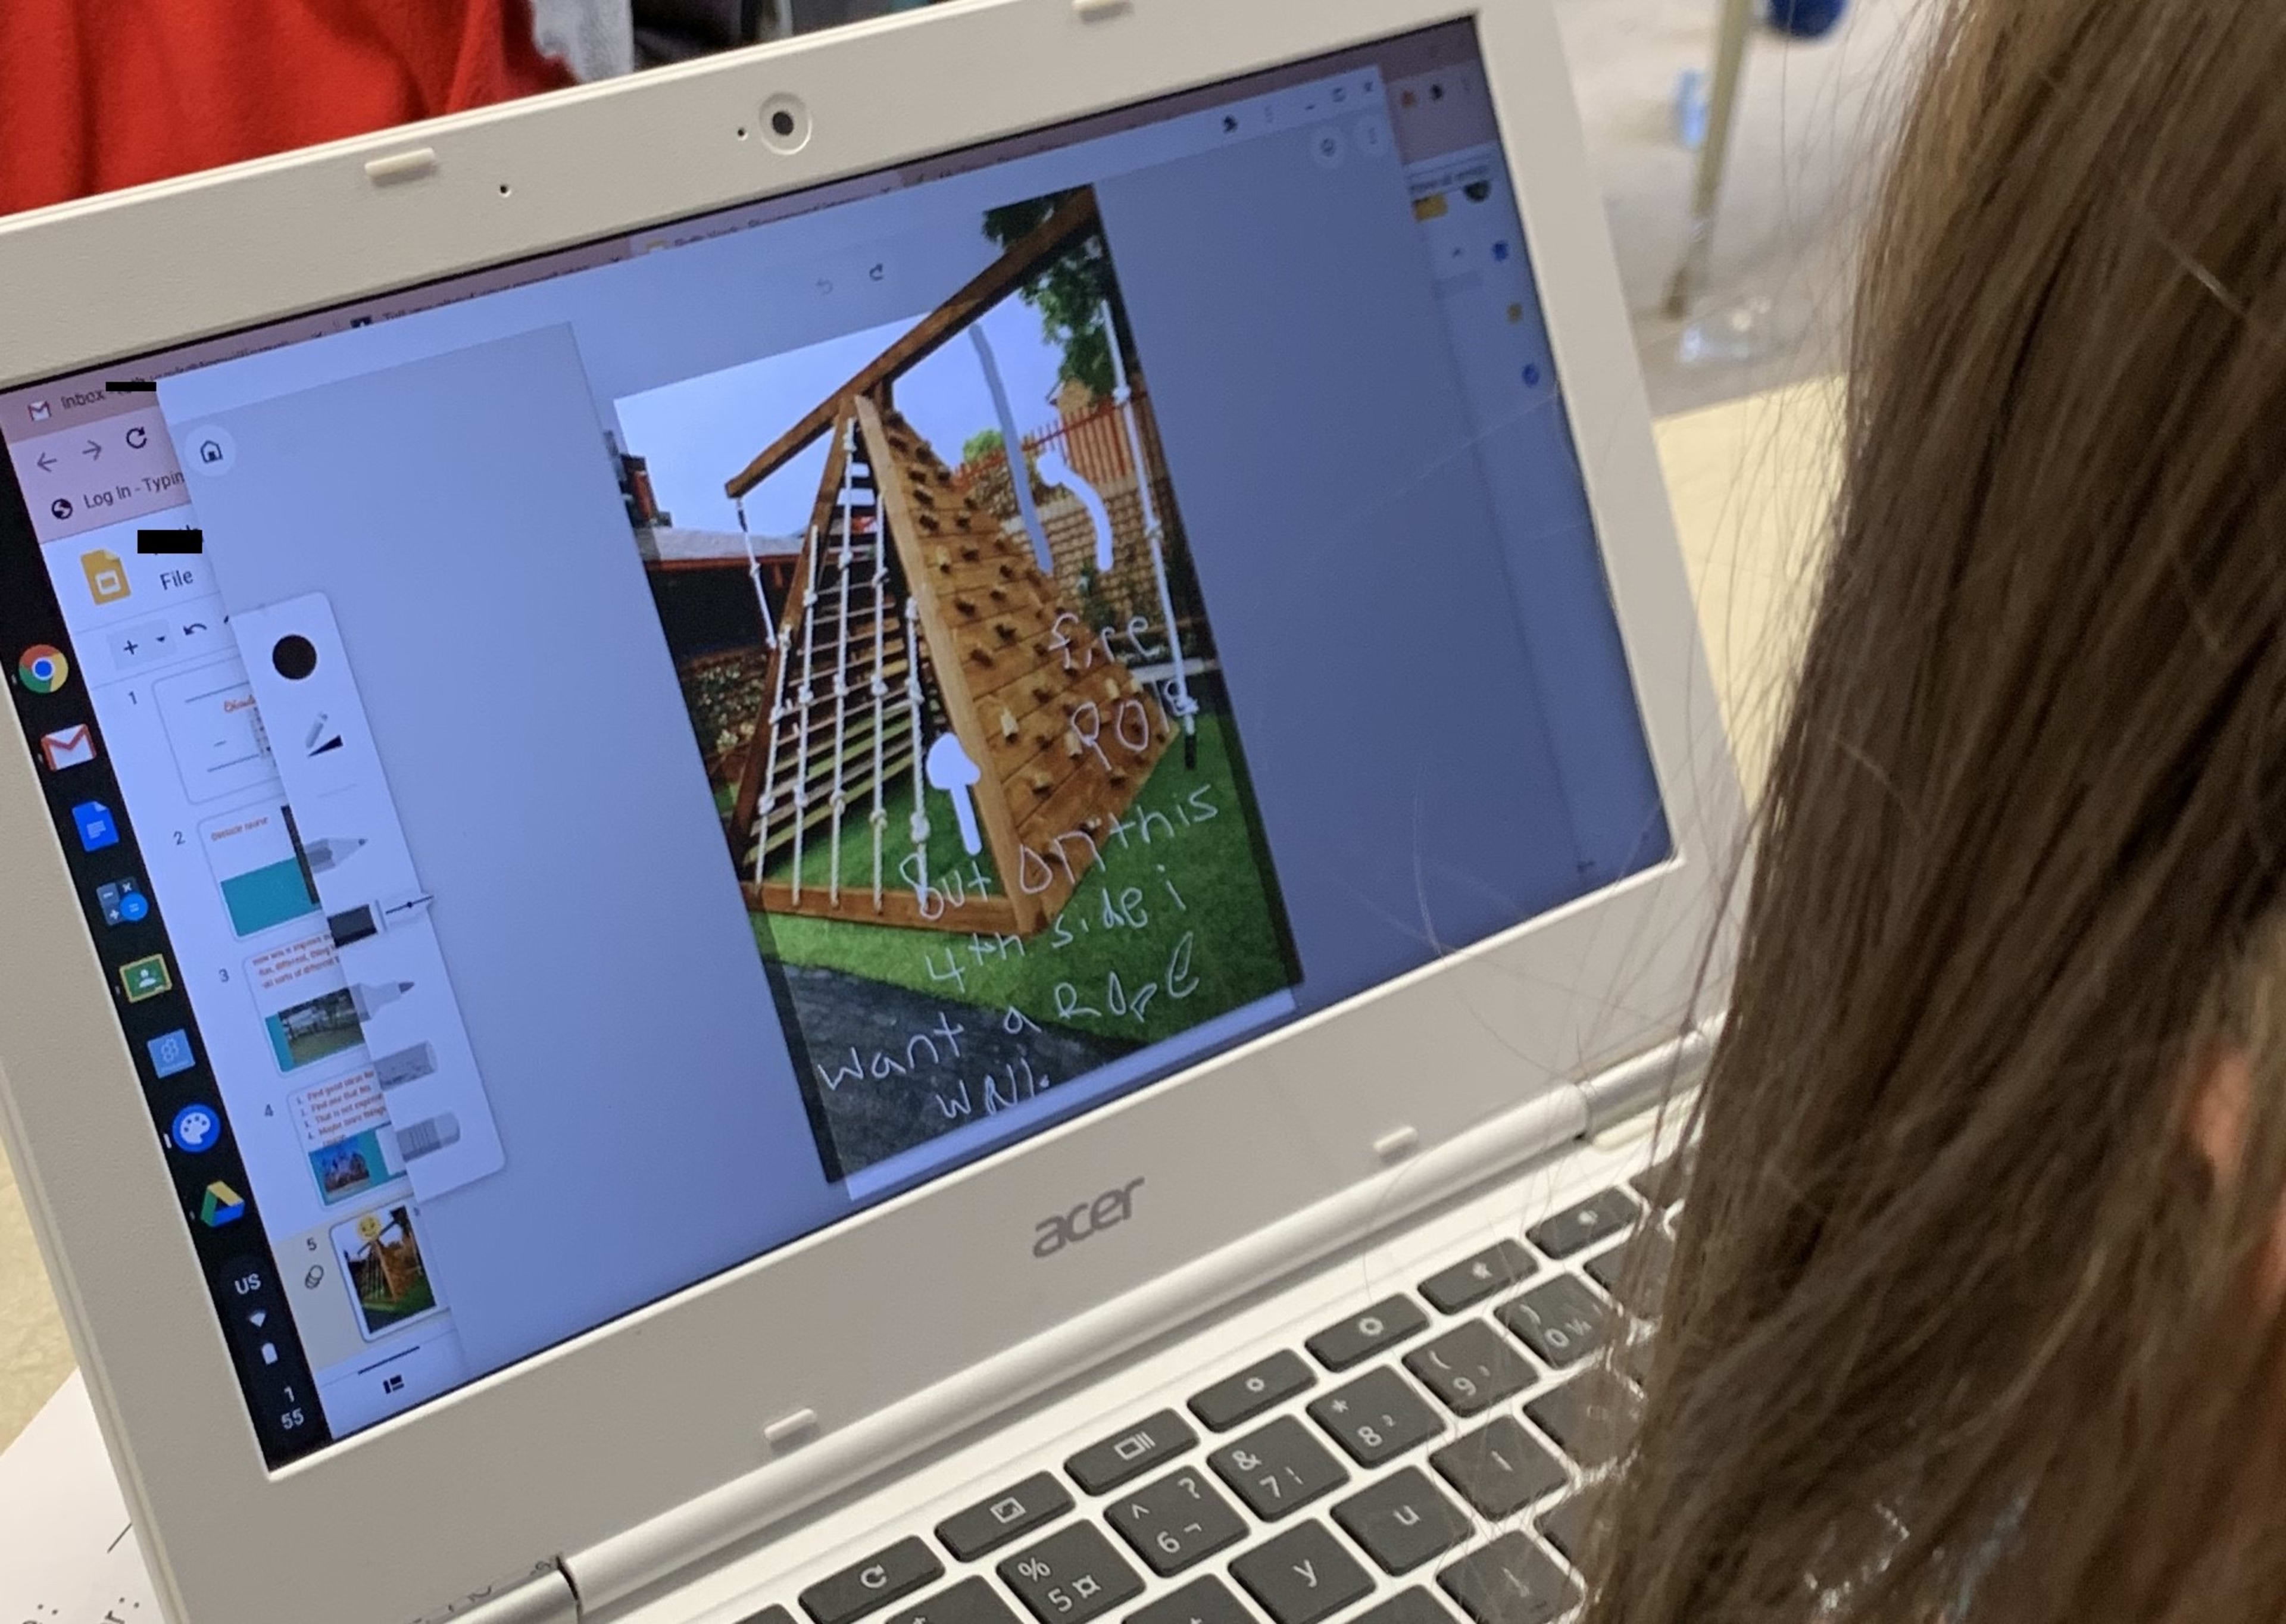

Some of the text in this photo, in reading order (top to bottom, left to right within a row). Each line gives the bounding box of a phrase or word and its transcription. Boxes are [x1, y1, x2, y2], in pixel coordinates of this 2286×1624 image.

[61, 389, 105, 409] Inbox
[84, 491, 114, 508] Log
[116, 486, 131, 499] In
[160, 570, 193, 591] File
[128, 691, 137, 705] 1
[1108, 784, 1217, 849] this
[173, 830, 186, 845] 2
[926, 932, 1025, 993] 4th
[1051, 887, 1148, 948] side
[219, 968, 230, 982] 3
[1003, 1006, 1041, 1033] a
[264, 1104, 274, 1118] 4
[1033, 1175, 1145, 1258] acer
[307, 1237, 317, 1251] 5
[235, 1273, 261, 1295] US
[1544, 1328, 1570, 1348] 0
[284, 1386, 295, 1403] 1
[1453, 1377, 1476, 1396] 9
[281, 1407, 304, 1429] 55
[1357, 1426, 1383, 1447] 8
[1231, 1450, 1262, 1471] &
[1259, 1476, 1281, 1498] 7
[1393, 1504, 1421, 1526] u
[1156, 1531, 1181, 1553] 6
[1017, 1557, 1051, 1582] %
[1293, 1559, 1317, 1588] y
[1047, 1588, 1073, 1613] 5
